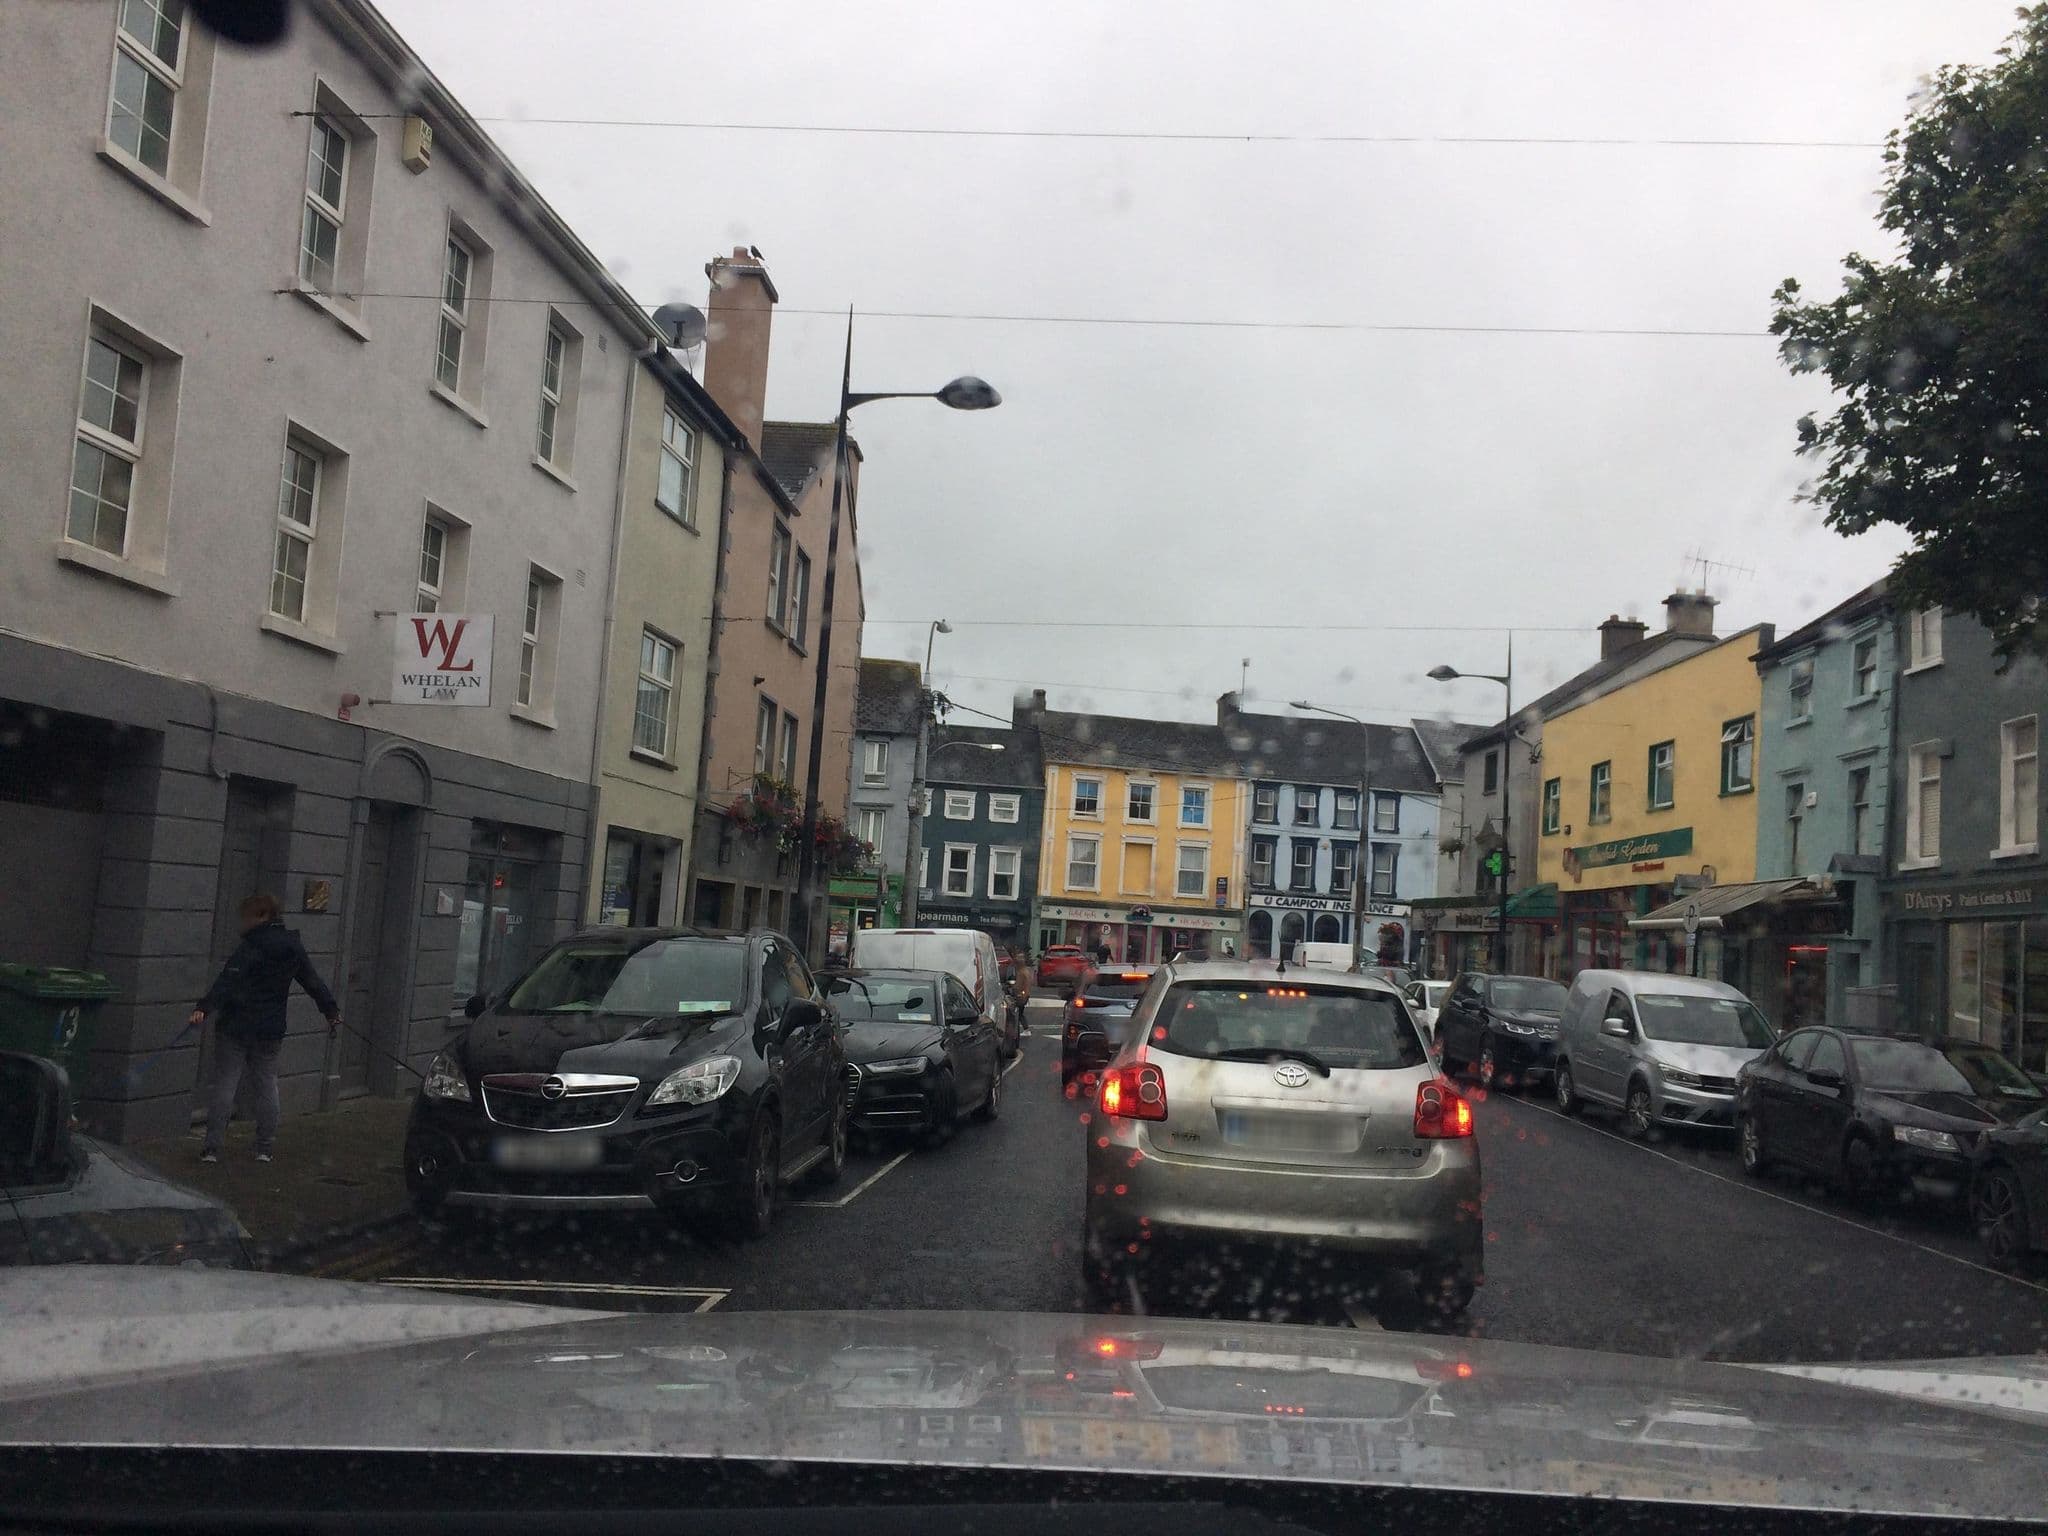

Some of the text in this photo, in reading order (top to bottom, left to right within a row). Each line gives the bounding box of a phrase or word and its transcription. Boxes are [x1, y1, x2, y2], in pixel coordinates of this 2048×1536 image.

[402, 674, 481, 688] WHELAN
[422, 688, 460, 700] LAW
[1276, 897, 1327, 909] CAMPION
[1333, 901, 1394, 914] INSANCE
